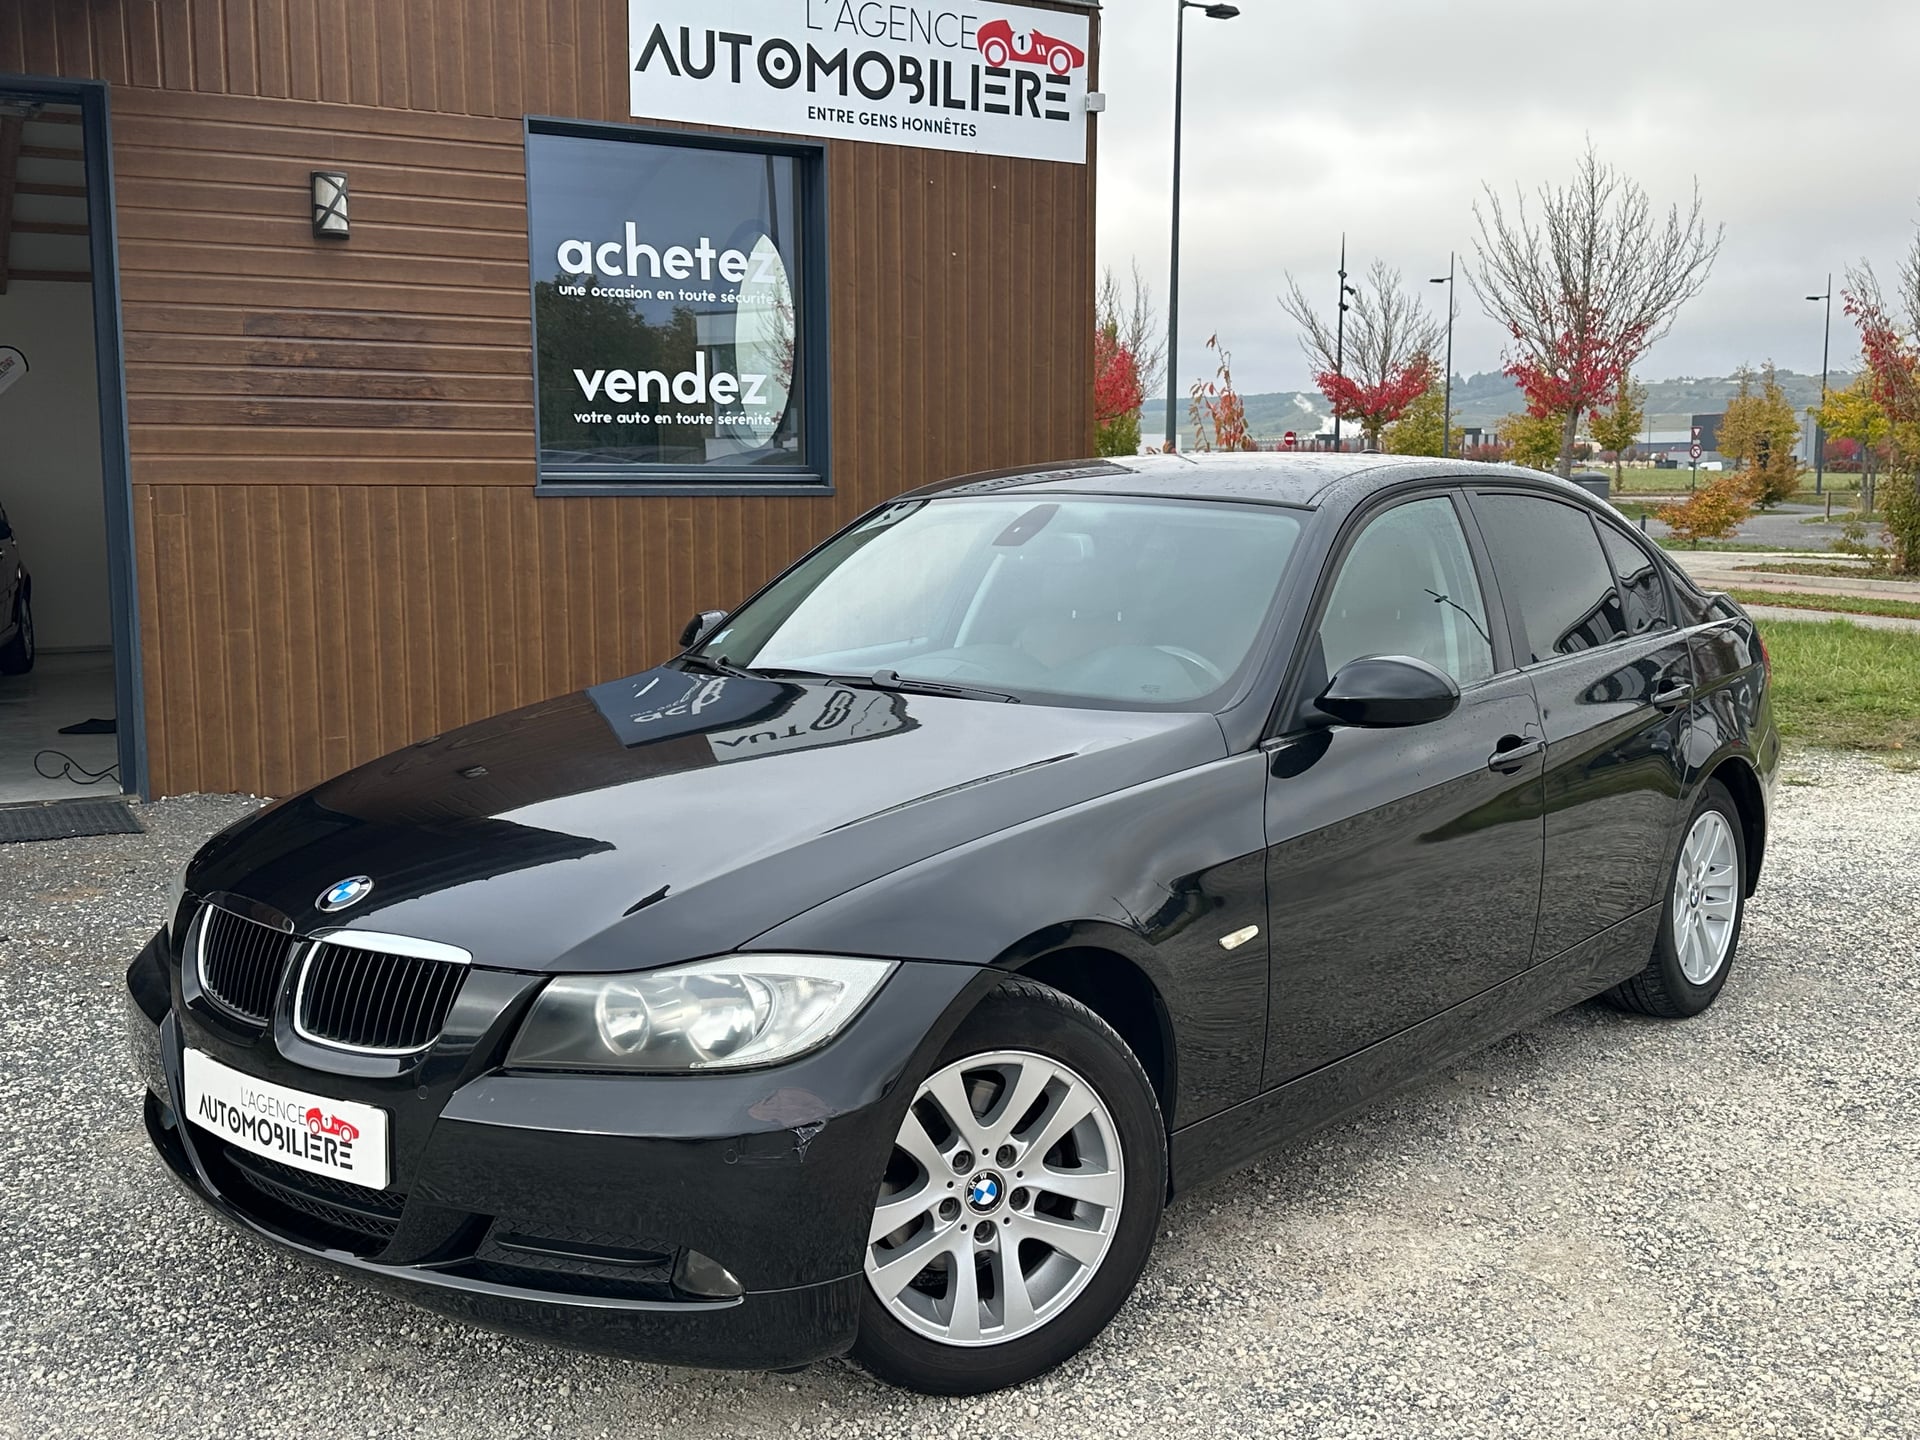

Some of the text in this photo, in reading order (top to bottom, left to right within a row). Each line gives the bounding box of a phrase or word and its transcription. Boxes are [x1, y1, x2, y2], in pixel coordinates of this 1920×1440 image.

[634, 22, 1071, 122] AUTOMOBILIERE
[807, 105, 977, 138] ENTRE GENS HONNÊTES
[557, 221, 777, 284] achetez
[559, 285, 586, 297] une
[590, 284, 652, 300] occasion
[656, 291, 674, 301] en
[679, 288, 715, 303] toute
[573, 351, 767, 405] vendez
[574, 412, 612, 424] votre
[616, 411, 650, 425] auto
[654, 413, 672, 425] en
[675, 411, 714, 426] toute
[240, 1087, 307, 1126] L'AGENCE
[199, 1092, 353, 1170] AUTOMOBILIERE
